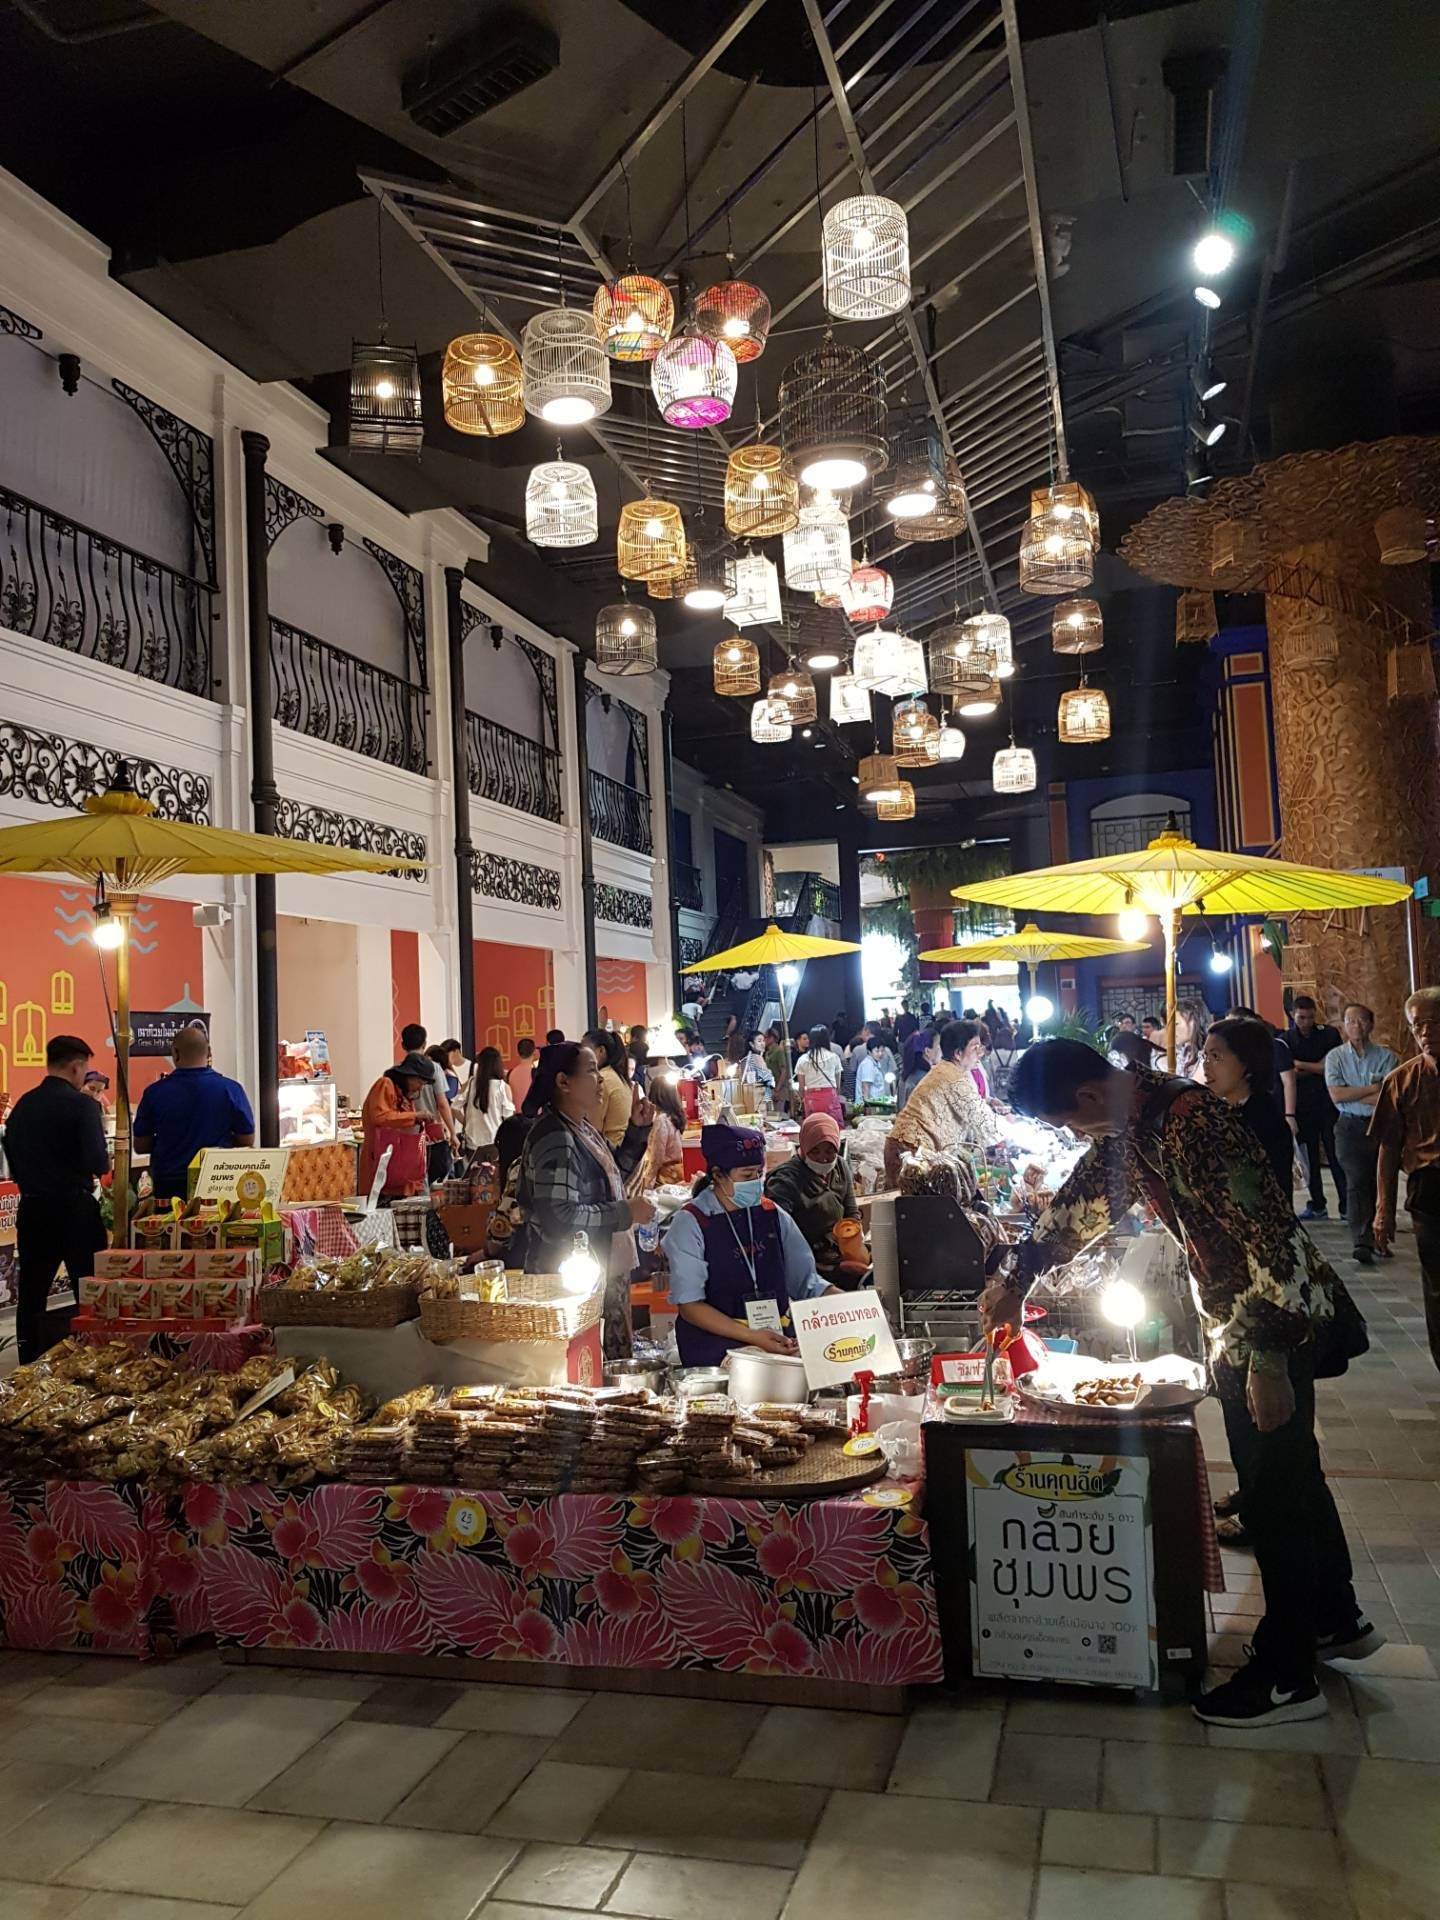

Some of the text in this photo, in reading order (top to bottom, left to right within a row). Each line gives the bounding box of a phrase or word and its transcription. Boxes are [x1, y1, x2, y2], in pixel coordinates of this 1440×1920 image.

[210, 1174, 234, 1183] ชุมพร
[801, 1306, 880, 1331] กล้วยอบทอด
[1002, 1504, 1115, 1556] กล้วย
[1108, 1513, 1115, 1522] 5
[992, 1557, 1133, 1609] ชุมพร
